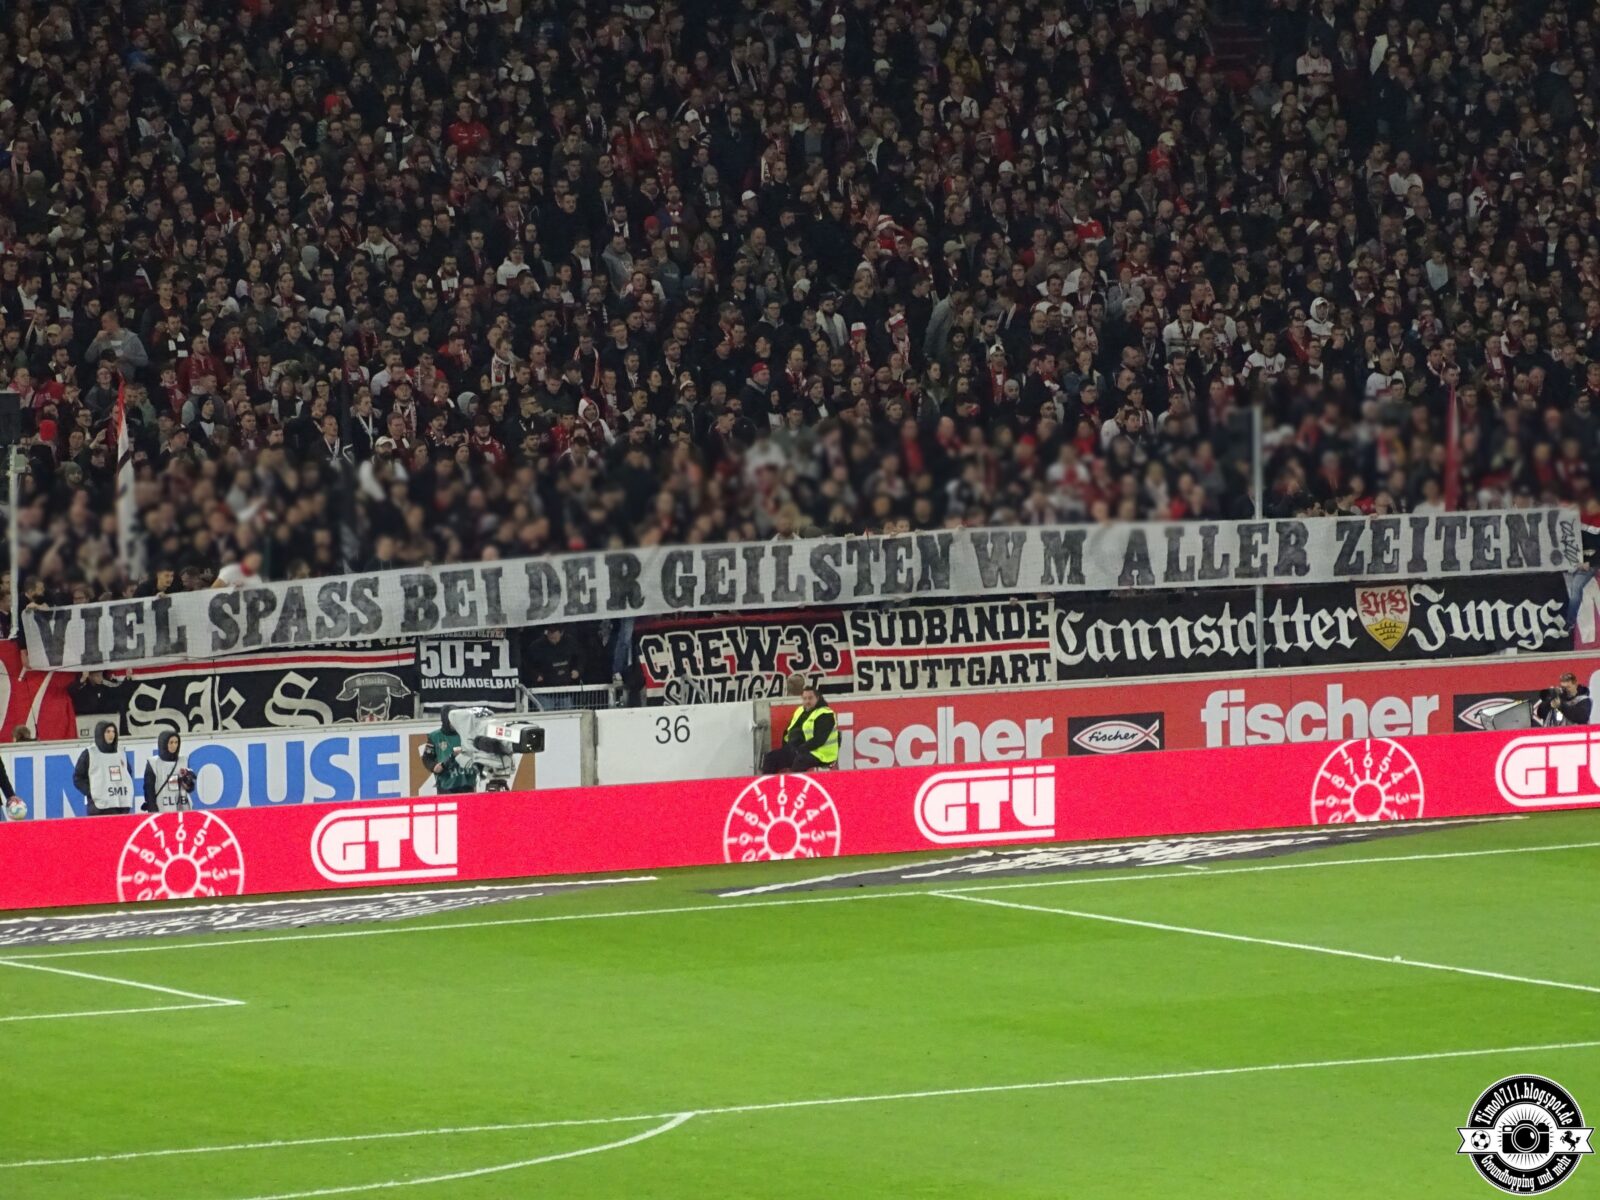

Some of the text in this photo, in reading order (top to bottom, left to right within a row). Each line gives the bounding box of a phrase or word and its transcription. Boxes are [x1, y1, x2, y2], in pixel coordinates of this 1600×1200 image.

[34, 598, 187, 666] VIEL
[209, 578, 383, 651] SPASS
[400, 567, 507, 632] BEI
[525, 553, 645, 621] DER
[661, 531, 953, 609] GEILSTEN
[1118, 520, 1311, 586] ALLER
[1334, 510, 1564, 577] ZEITEN!
[850, 603, 1049, 646] SÜDBANDE
[1056, 597, 1358, 666] Cannstatter
[1408, 583, 1569, 651] Jungs
[420, 638, 519, 677] 50+1
[857, 652, 1052, 691] STUTTGART
[655, 714, 691, 744] 36
[836, 705, 1053, 771] ischer
[1088, 730, 1138, 742] fischer
[1201, 684, 1439, 748] fischer
[919, 765, 1055, 837] GTÜ
[316, 803, 457, 876] GTÜ
